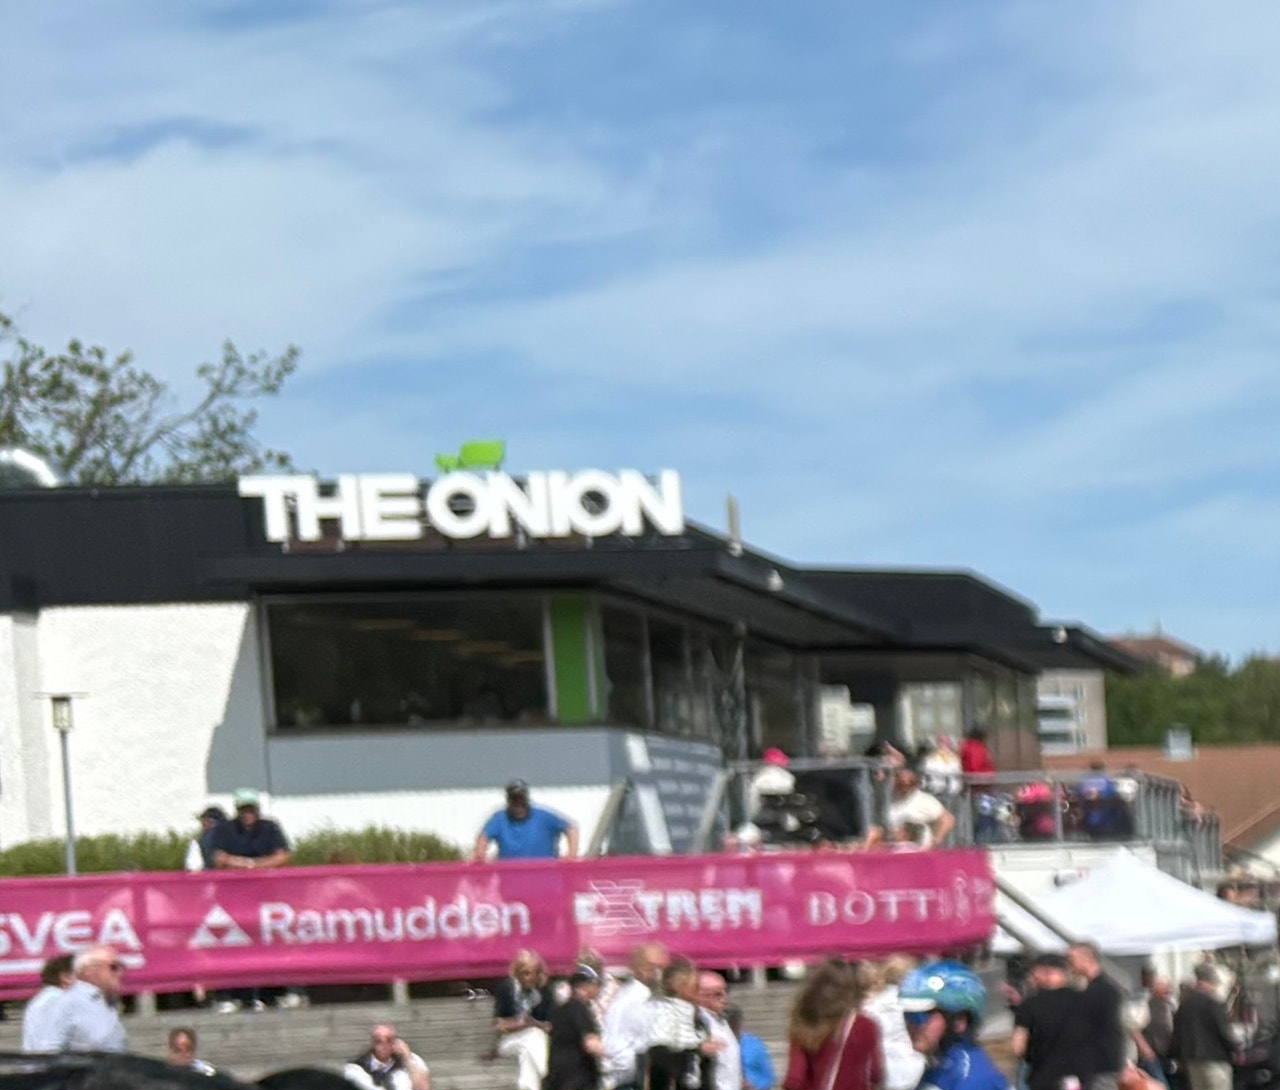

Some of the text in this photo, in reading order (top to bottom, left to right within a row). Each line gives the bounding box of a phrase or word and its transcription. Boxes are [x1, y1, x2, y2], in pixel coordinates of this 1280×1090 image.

[238, 469, 685, 543] THE ONION
[258, 894, 532, 946] Ramudden
